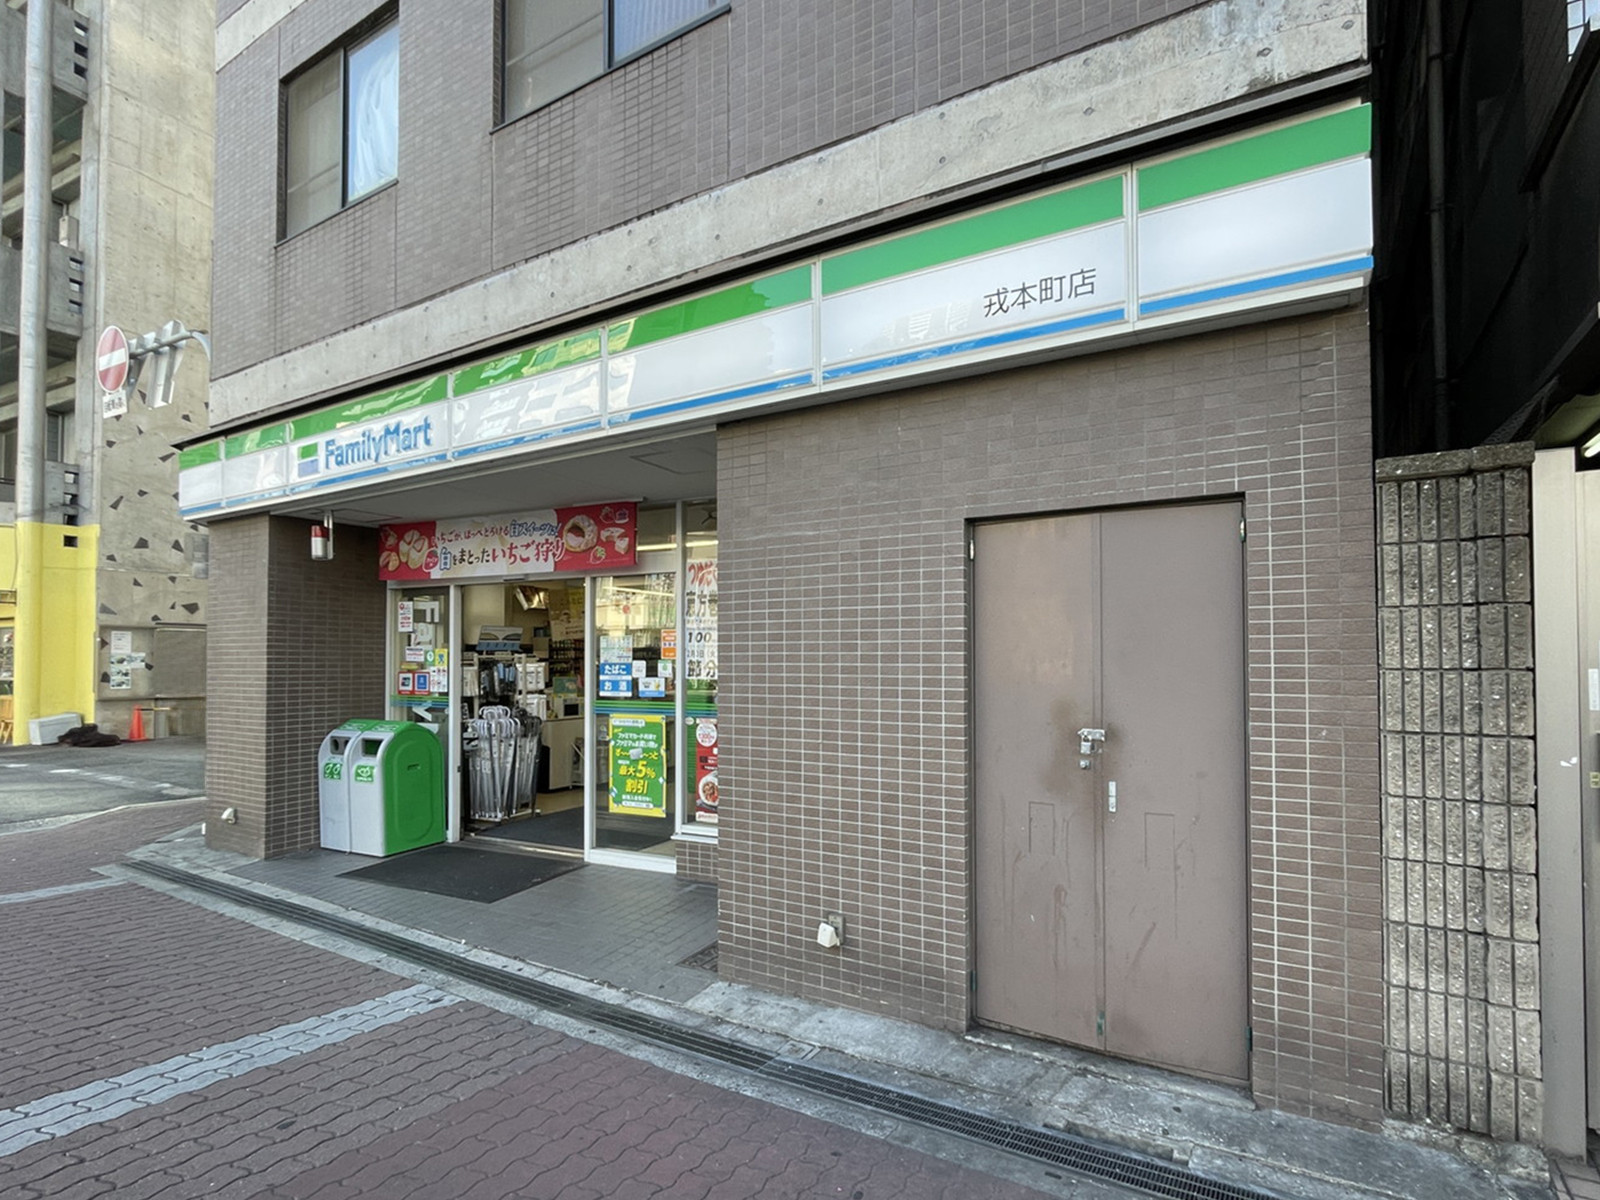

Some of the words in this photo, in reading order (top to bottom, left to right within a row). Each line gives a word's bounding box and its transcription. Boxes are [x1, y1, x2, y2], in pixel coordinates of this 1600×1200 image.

[983, 268, 1096, 317] 戎本町店
[325, 415, 432, 470] FamilyMart
[604, 664, 627, 675] たばこ
[625, 778, 648, 794] 割引
